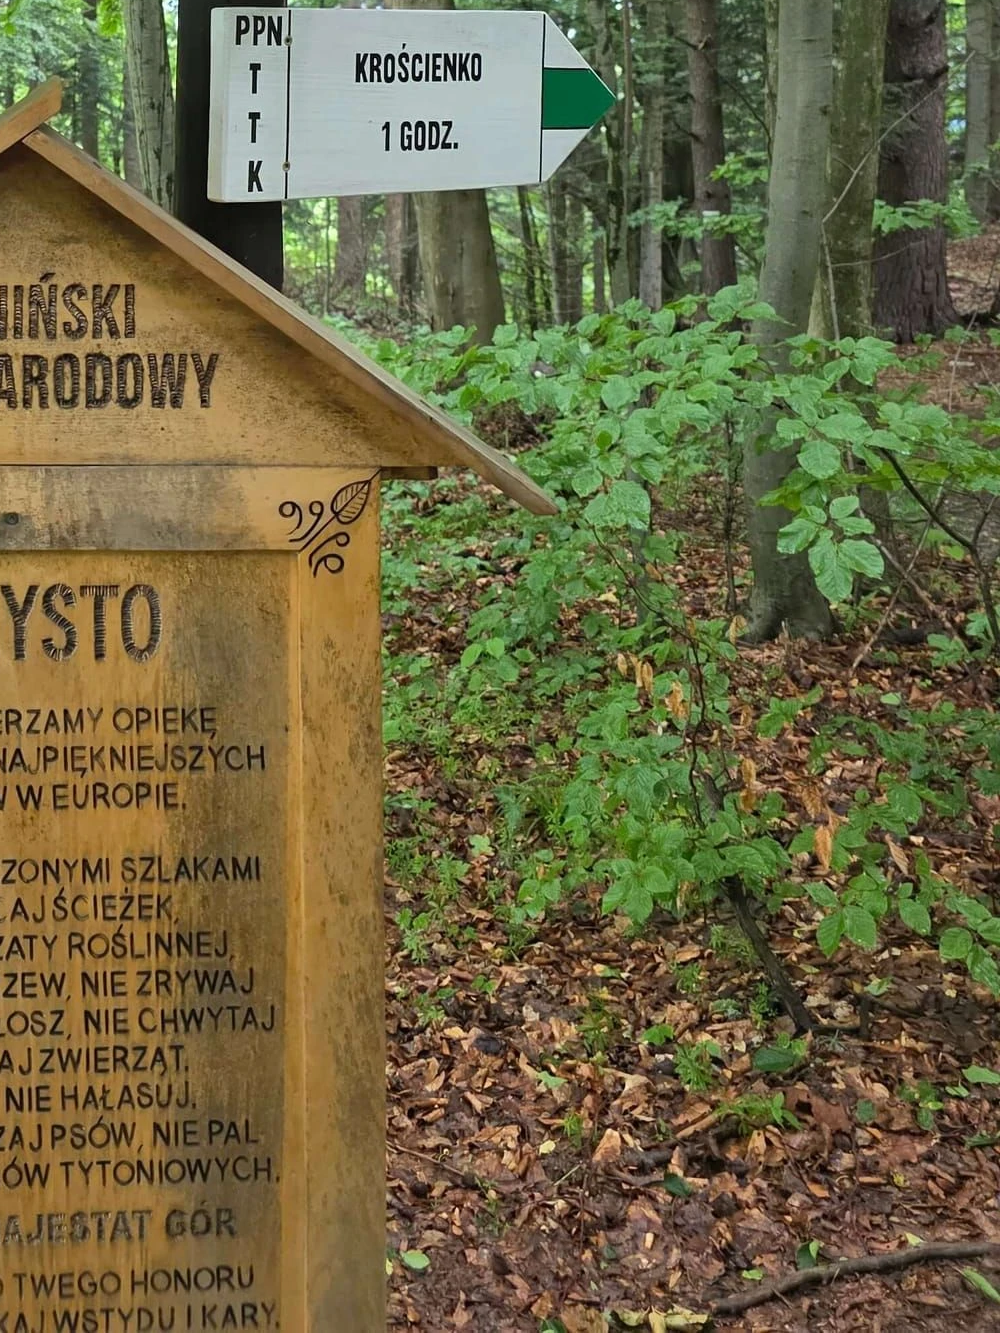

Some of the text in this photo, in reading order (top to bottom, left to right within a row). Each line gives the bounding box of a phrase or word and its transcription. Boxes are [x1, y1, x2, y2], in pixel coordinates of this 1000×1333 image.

[235, 16, 282, 46] PPN
[249, 63, 261, 94] T
[355, 43, 482, 83] KROŚCIENKO
[248, 112, 260, 143] T
[382, 121, 458, 151] 1 GODZ.
[248, 161, 262, 192] K
[112, 706, 217, 741] OPIEKĘ
[16, 785, 46, 812] W
[52, 781, 187, 811] EUROPIE.
[122, 856, 261, 883] SZLAKAMI
[52, 888, 178, 925] ŚCIEŻEK,
[68, 925, 235, 963] ROŚLINNEJ,
[82, 970, 128, 998] NIE
[136, 968, 254, 996] ZRYWAJ
[84, 1008, 128, 1036] NIE
[138, 1004, 276, 1034] CHWYTAJ
[40, 1044, 188, 1078] ZWIERZĄT.
[6, 1086, 51, 1112] NIE
[61, 1082, 198, 1112] HAŁASUJ.
[51, 1117, 144, 1152] PSÓW,
[152, 1122, 199, 1148] NIE
[208, 1120, 258, 1146] PAL
[61, 1158, 280, 1187] TYTONIOWYCH.
[165, 1200, 238, 1238] GÓR
[12, 1270, 121, 1301] TWEGO
[130, 1265, 254, 1297] HONORU
[53, 1306, 175, 1333] WSTYDU
[186, 1304, 192, 1329] I
[201, 1301, 280, 1331] KARY.
